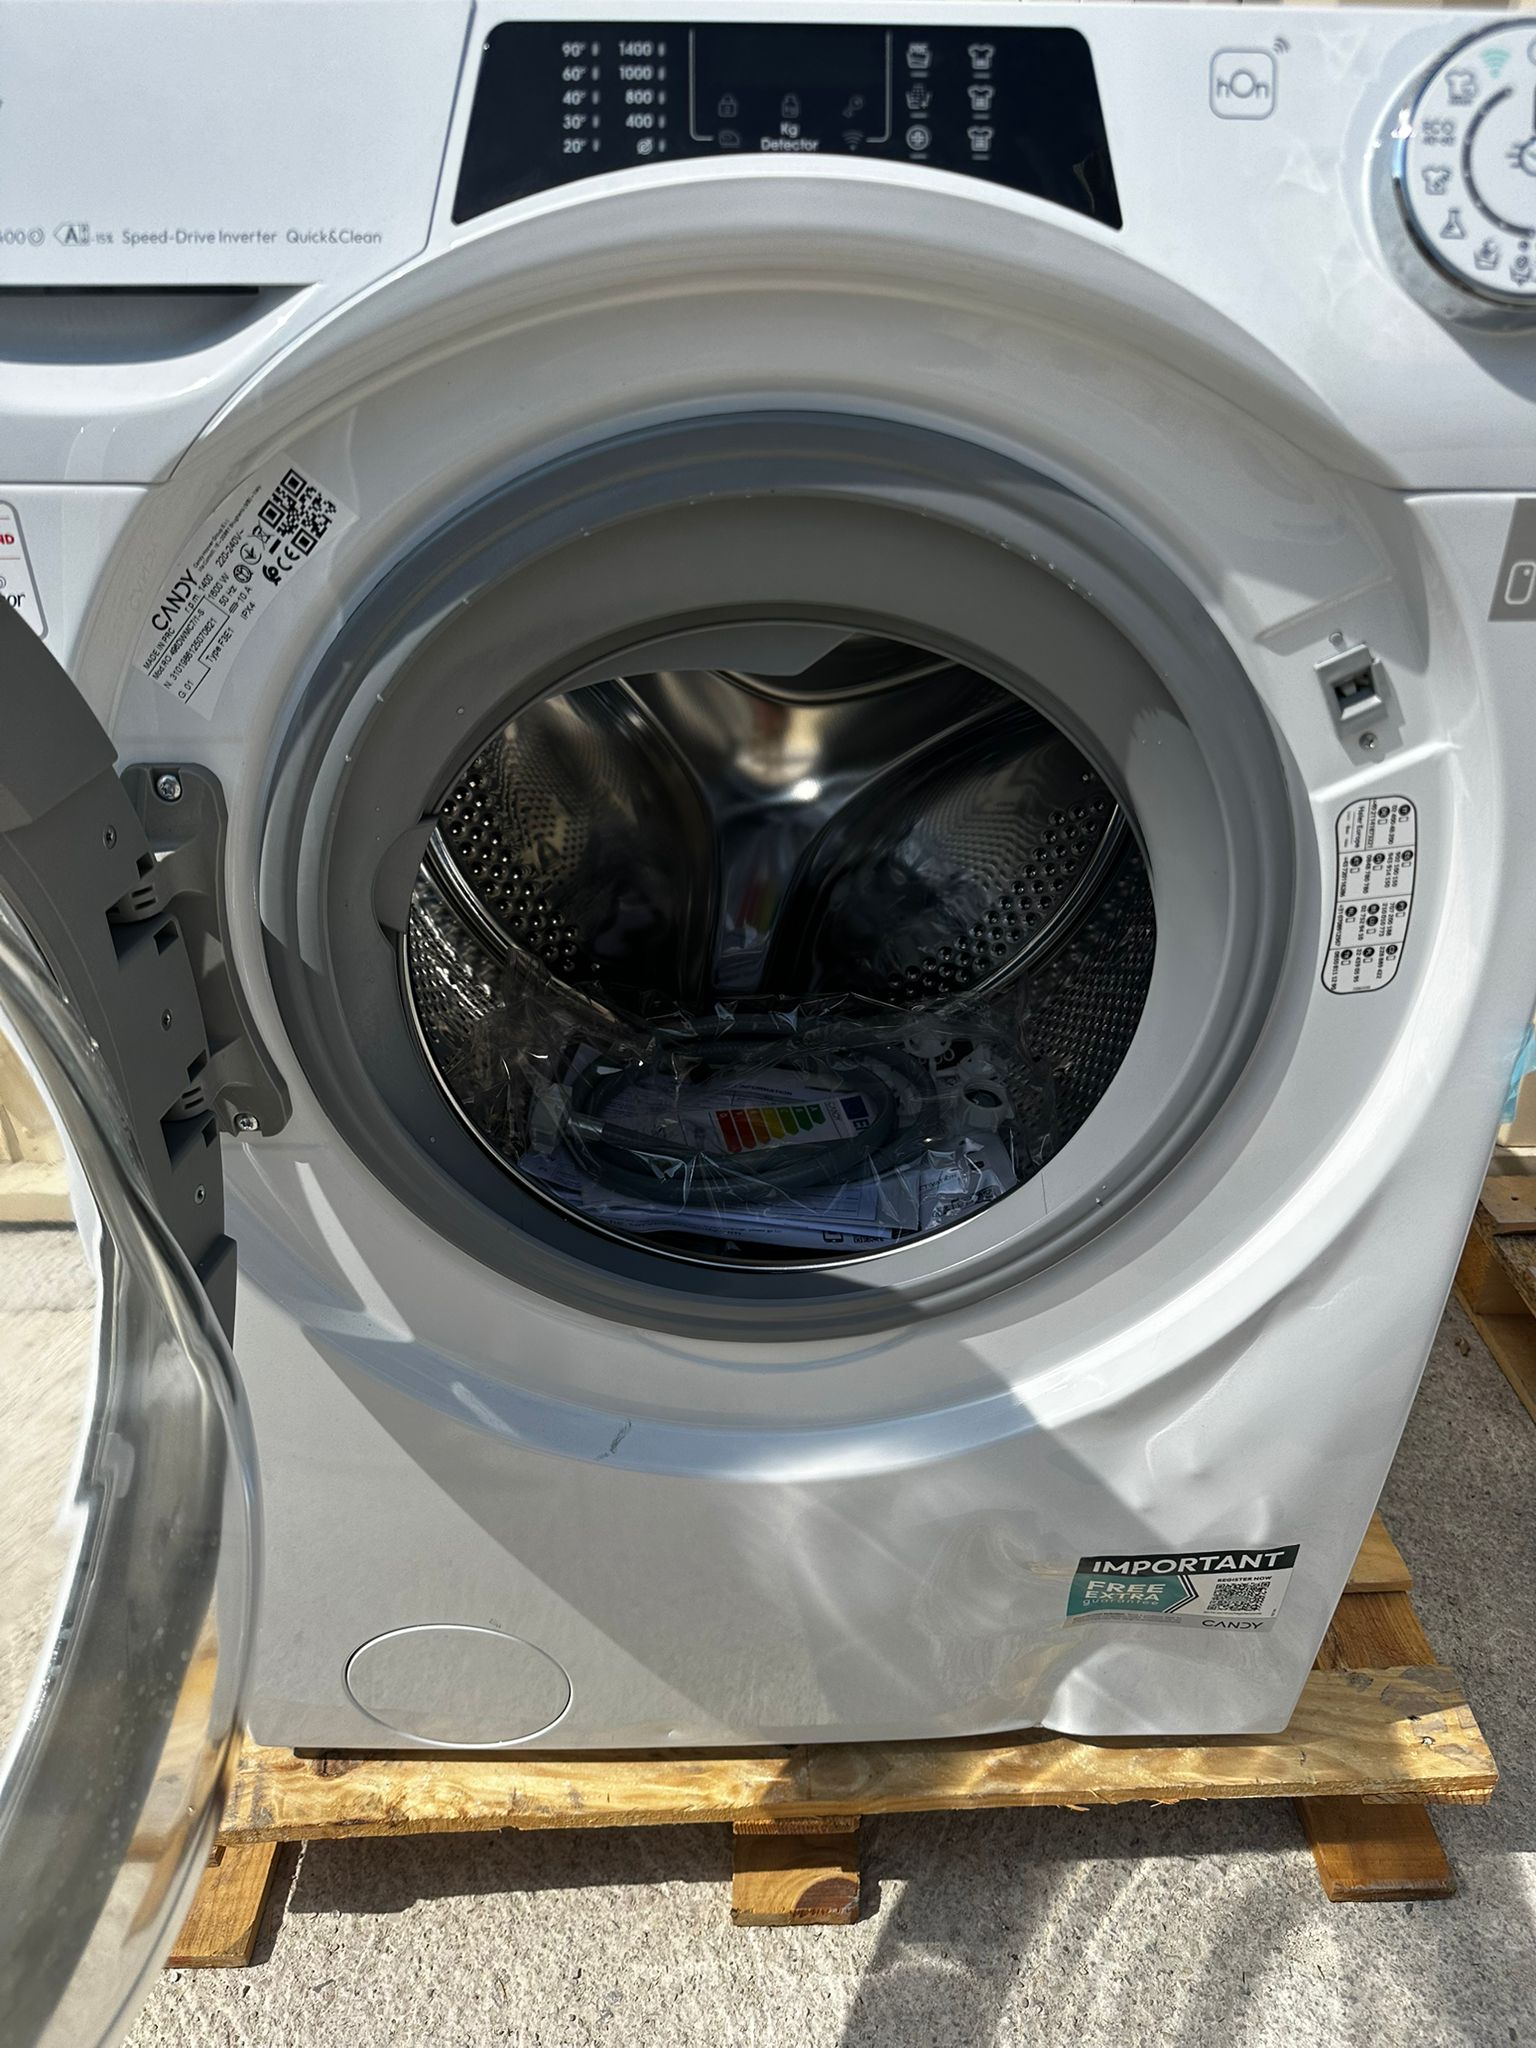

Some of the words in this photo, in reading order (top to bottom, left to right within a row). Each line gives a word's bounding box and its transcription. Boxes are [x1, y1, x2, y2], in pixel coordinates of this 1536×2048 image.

[619, 41, 653, 56] 1400
[619, 65, 653, 80] 1000
[625, 89, 652, 104] 800
[625, 114, 653, 128] 400
[781, 122, 798, 137] Kg
[760, 137, 818, 151] Detector
[0, 227, 26, 245] 00
[219, 229, 277, 244] Inverter
[286, 229, 382, 244] Quick&Clean
[197, 573, 214, 592] 1400
[218, 572, 230, 583] W
[152, 568, 198, 631] CANDY
[217, 594, 229, 607] 50
[225, 584, 237, 596] Hz
[236, 591, 248, 603] 10
[242, 585, 252, 594] A
[239, 601, 256, 620] IPX4
[141, 649, 160, 670] MADE
[155, 640, 165, 651] IN
[160, 626, 175, 643] PRC
[205, 644, 223, 664] Type
[216, 626, 235, 647] F3E1
[183, 679, 194, 690] 01
[1092, 1551, 1285, 1575] IMPORTANT
[1087, 1580, 1166, 1594] FREE
[1084, 1590, 1160, 1601] EXTRA
[1202, 1619, 1264, 1629] CANDY
